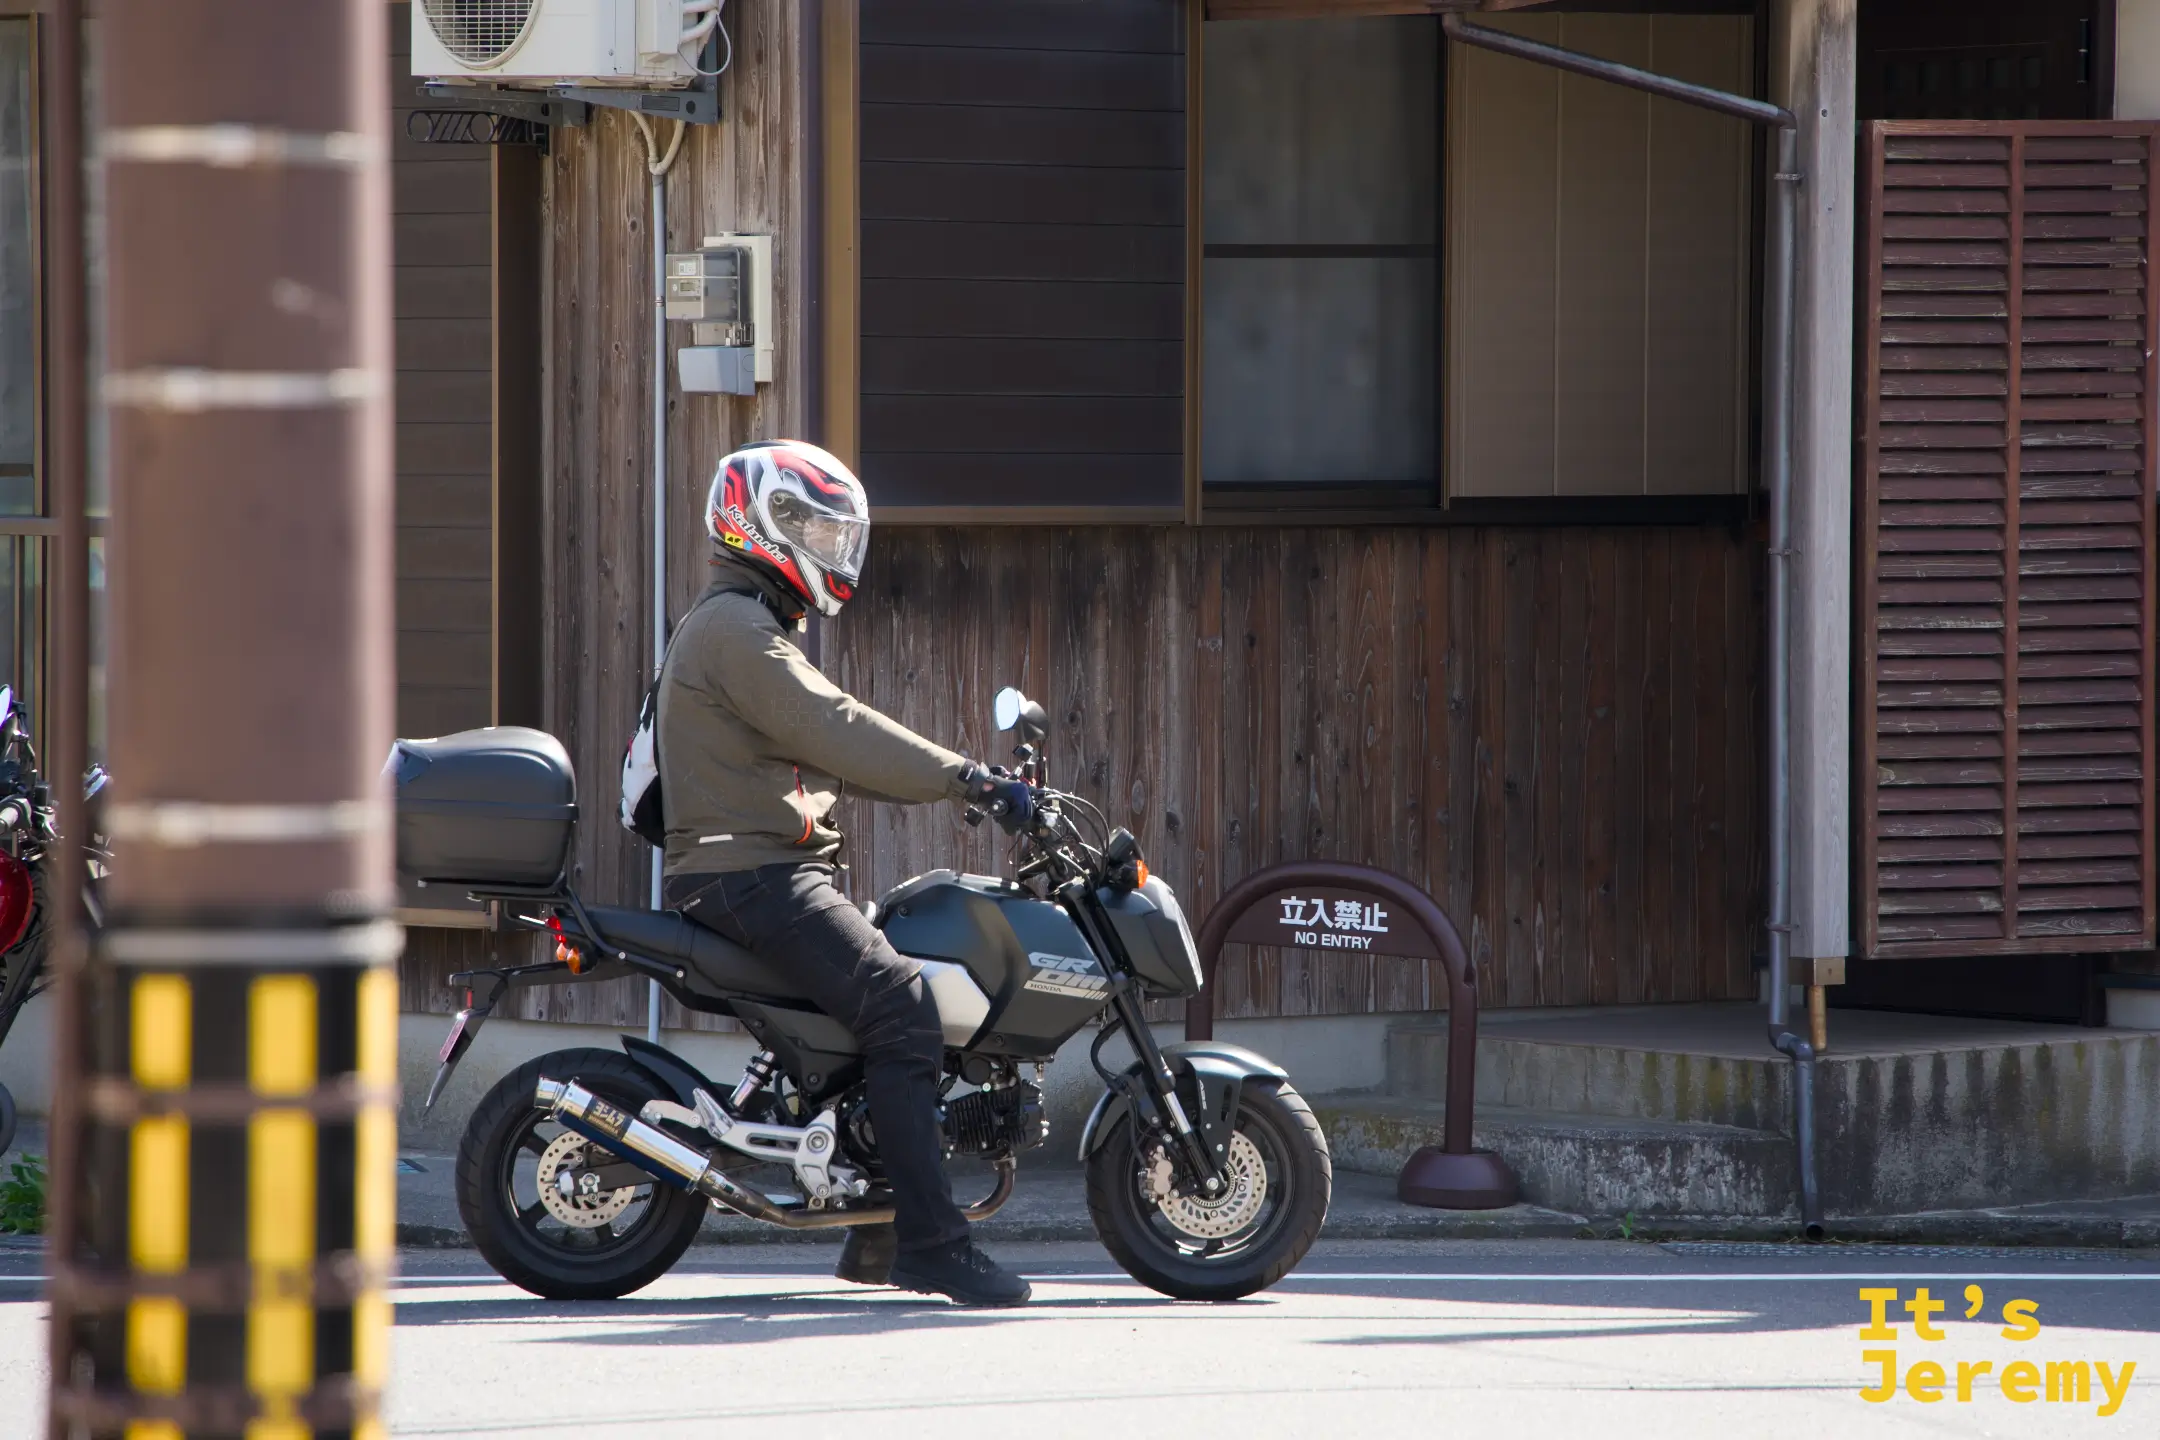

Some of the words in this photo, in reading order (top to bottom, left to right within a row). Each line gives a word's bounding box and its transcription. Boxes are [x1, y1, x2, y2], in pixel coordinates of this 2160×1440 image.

[1280, 896, 1388, 932] 立入禁止
[1295, 931, 1317, 945] NO
[1321, 934, 1372, 949] ENTRY
[1030, 983, 1062, 993] HONDA
